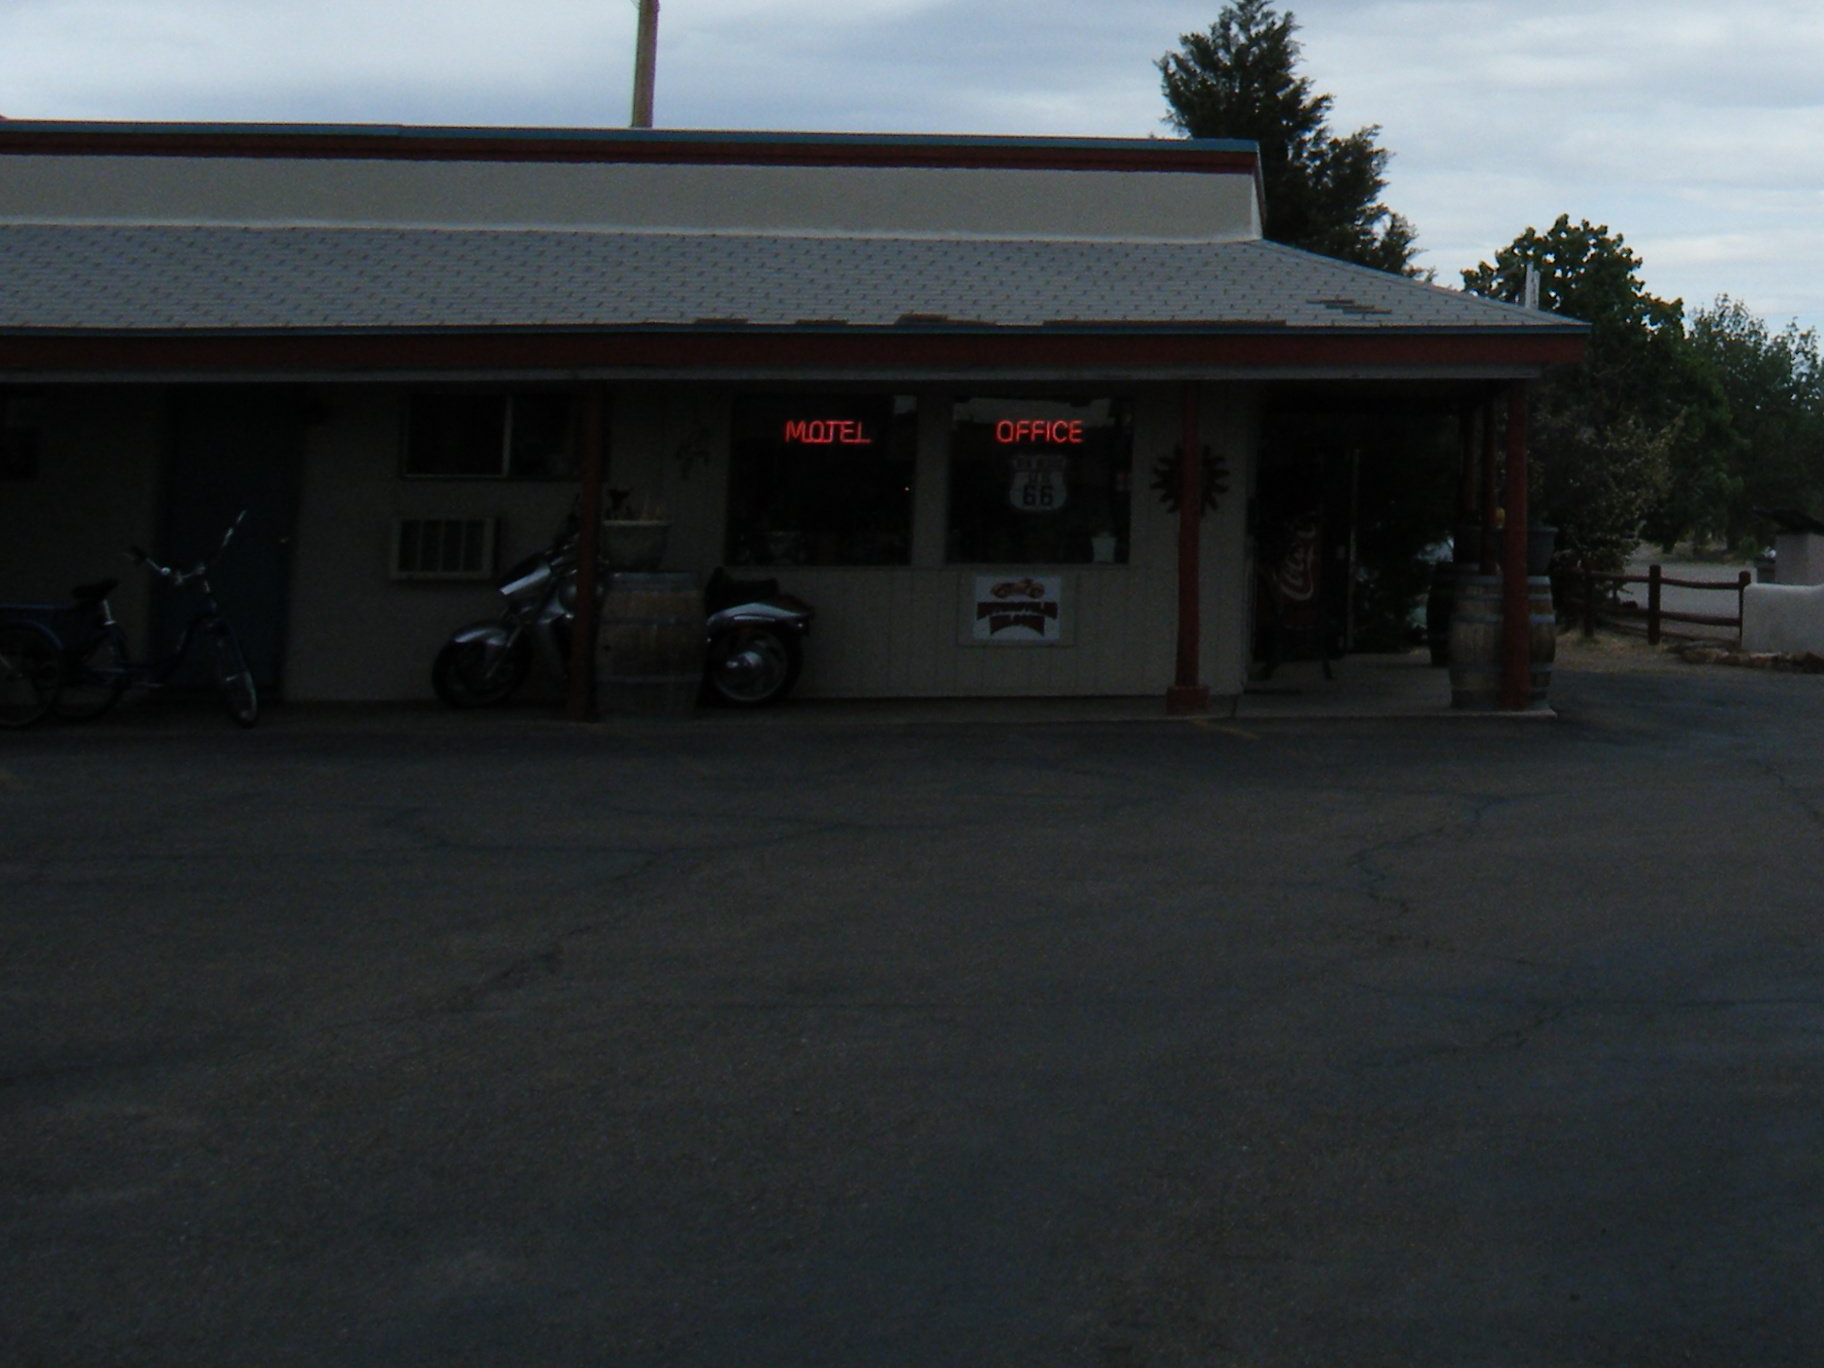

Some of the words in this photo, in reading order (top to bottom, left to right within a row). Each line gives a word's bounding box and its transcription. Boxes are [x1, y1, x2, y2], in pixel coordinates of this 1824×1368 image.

[784, 419, 873, 446] MOTEL
[994, 419, 1085, 445] OFFICE
[1022, 485, 1054, 507] 66
